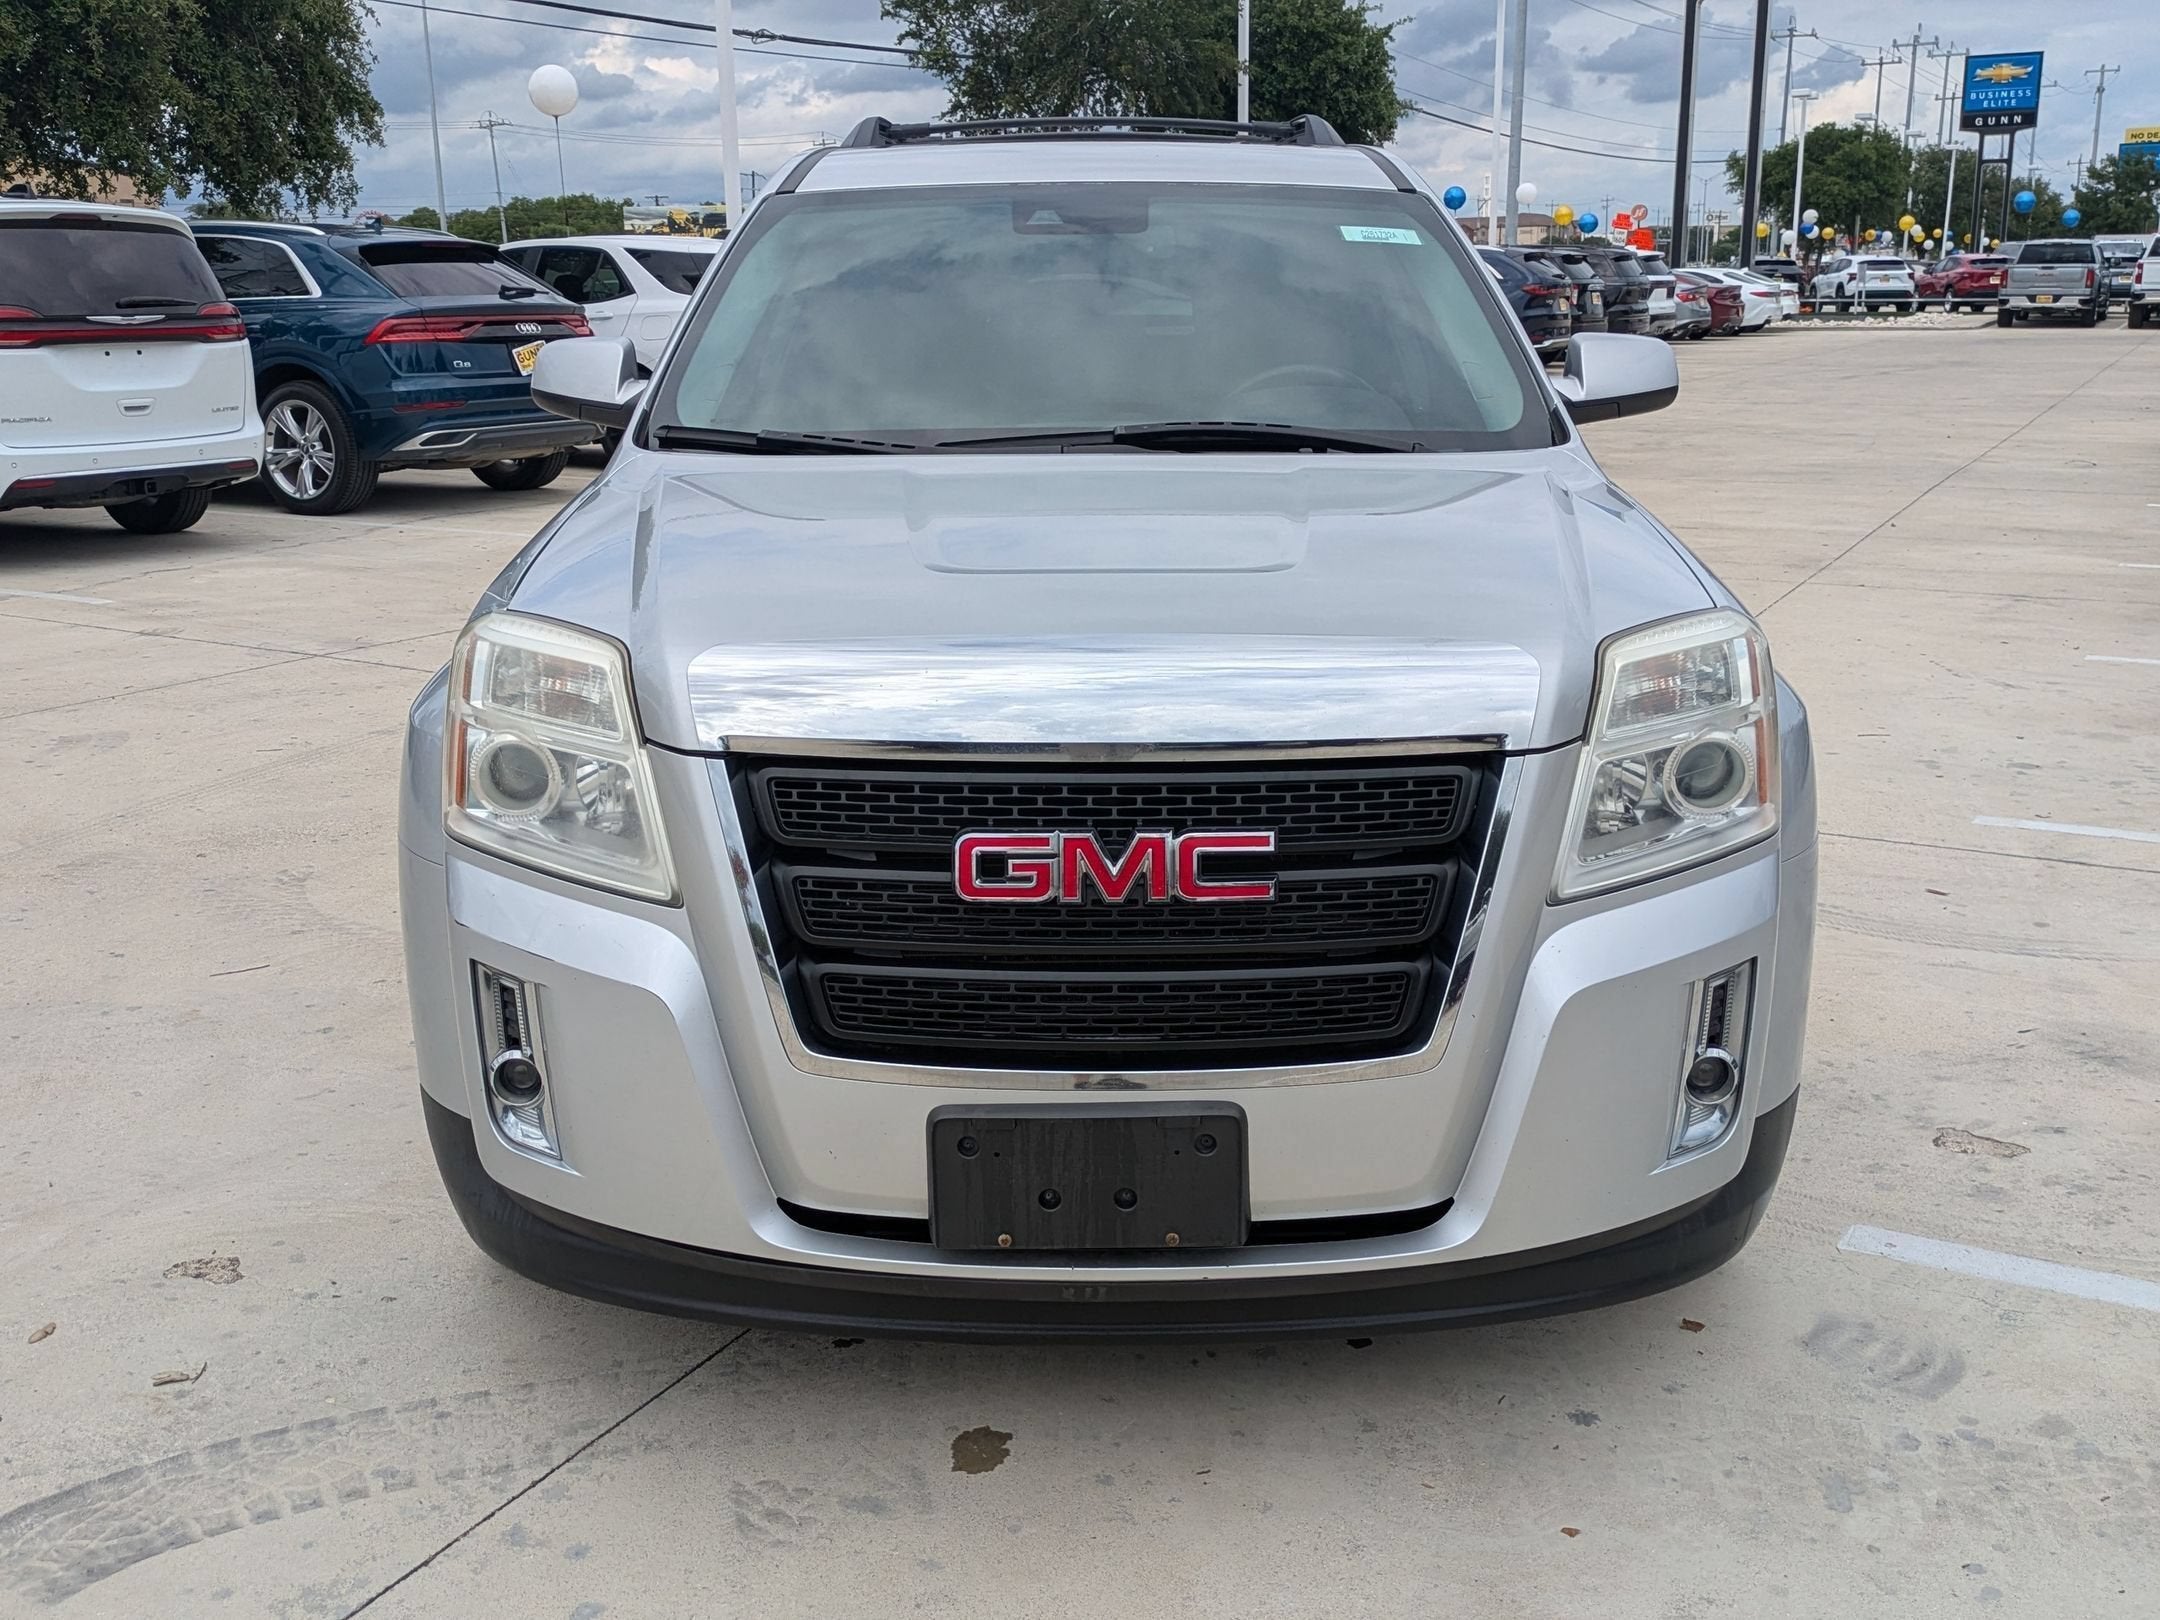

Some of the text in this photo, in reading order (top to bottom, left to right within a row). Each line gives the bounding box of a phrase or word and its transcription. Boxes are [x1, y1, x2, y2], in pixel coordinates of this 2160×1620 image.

[1970, 89, 2032, 100] BUSINESS
[1983, 99, 2017, 108] ELITE
[1975, 114, 2022, 127] GUNN
[2131, 131, 2160, 140] NO DE
[517, 347, 540, 364] GUN
[453, 360, 472, 368] Q8
[954, 829, 1277, 904] GMC
